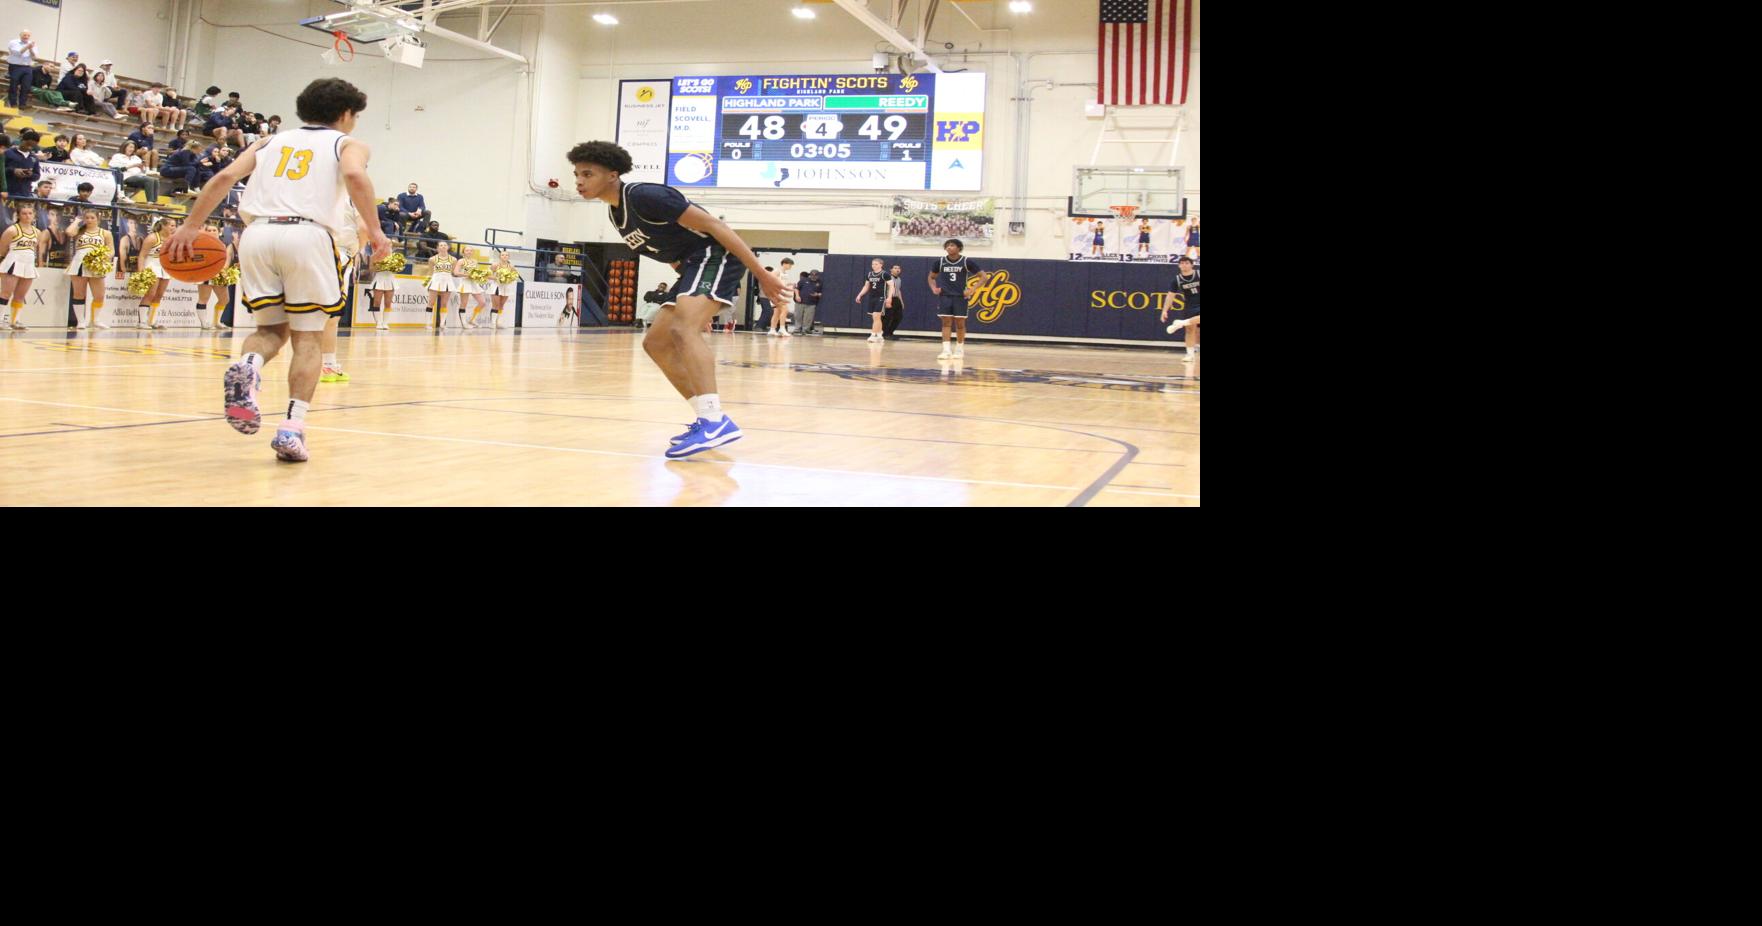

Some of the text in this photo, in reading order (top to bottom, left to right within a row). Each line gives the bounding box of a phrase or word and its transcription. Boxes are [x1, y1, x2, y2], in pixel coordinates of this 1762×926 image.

[700, 78, 715, 86] GO
[763, 76, 888, 89] FIGHTIN' SCOTS
[724, 98, 820, 107] HIGHLAND PARK
[879, 97, 926, 107] REEDY
[739, 115, 785, 140] 48
[815, 122, 828, 137] 4
[858, 115, 908, 141] 49
[731, 149, 742, 160] 0
[790, 143, 852, 158] 03:05
[901, 150, 912, 161] 1
[273, 146, 314, 181] 13
[796, 168, 887, 180] JOHNSON
[1069, 253, 1083, 261] 12
[1120, 253, 1133, 262] 13
[949, 273, 957, 282] 3
[391, 294, 429, 304] OLLESON
[525, 289, 550, 300] CULWELL
[554, 291, 565, 300] SON
[1090, 290, 1186, 311] SCOTS
